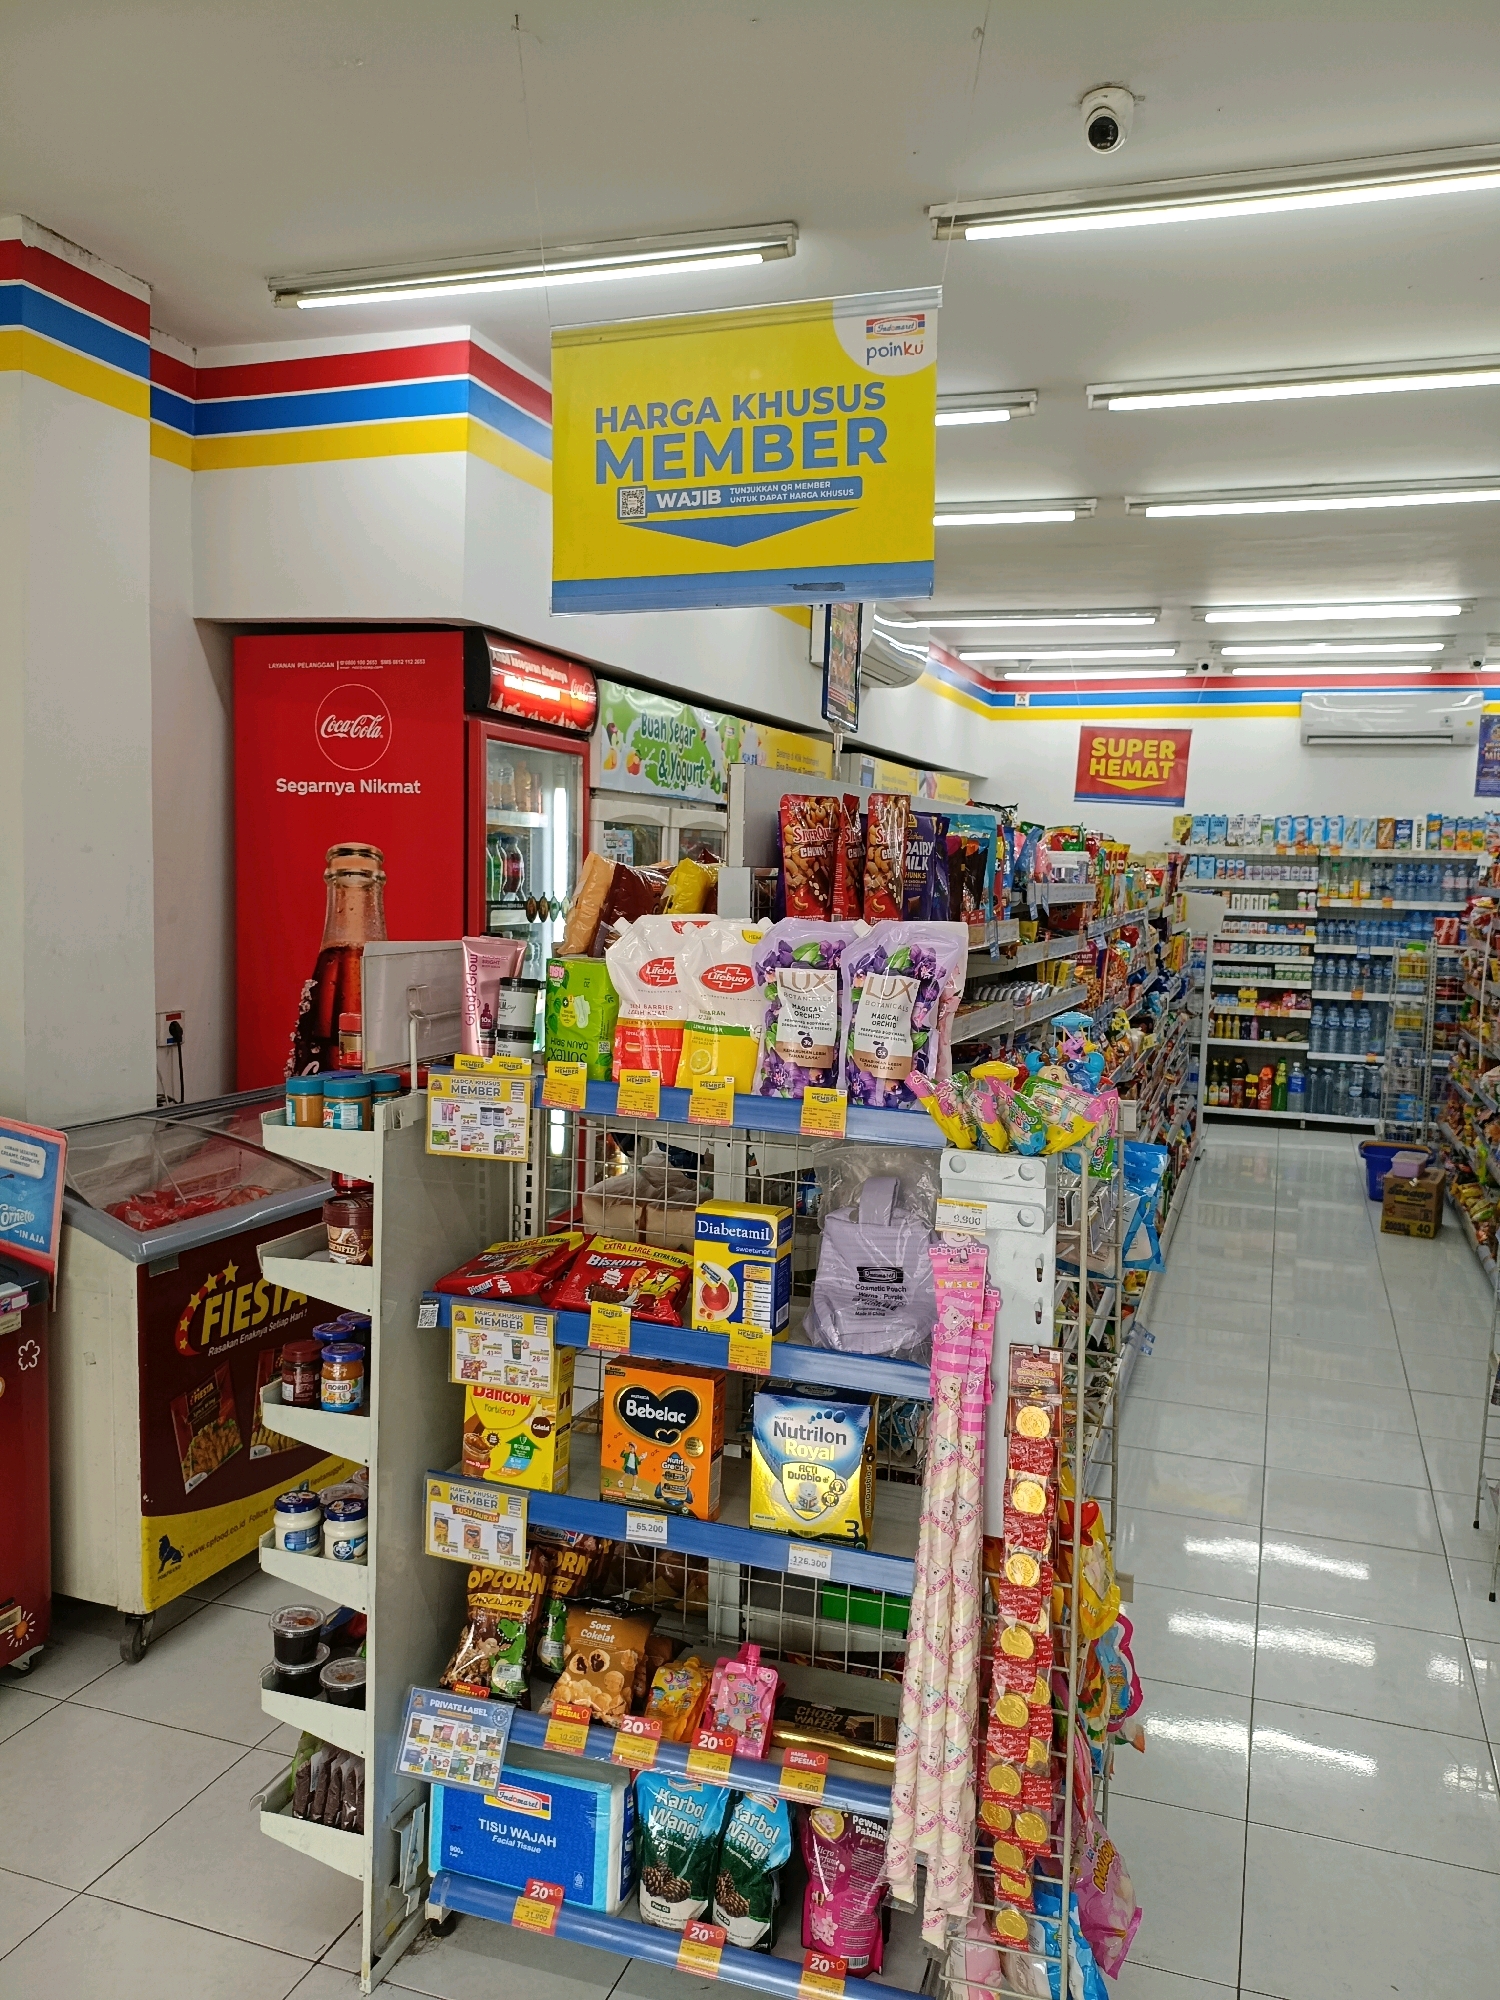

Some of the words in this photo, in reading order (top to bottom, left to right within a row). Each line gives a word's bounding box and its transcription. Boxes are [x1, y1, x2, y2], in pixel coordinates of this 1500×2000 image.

[866, 340, 924, 366] poinku
[595, 396, 722, 434] HARGA
[732, 381, 886, 422] KHUSUS
[596, 416, 888, 485] MEMBER
[730, 484, 779, 495] TUNJUKKAN
[781, 482, 794, 492] QR
[795, 480, 831, 491] MEMBER
[730, 494, 758, 504] UNTUK
[759, 492, 788, 502] DAPAT
[789, 490, 819, 500] HARGA
[820, 488, 855, 499] KHUSUS
[656, 488, 722, 509] WAJIB
[641, 712, 667, 743] Buah
[669, 715, 697, 752] Segar
[1091, 736, 1176, 760] SUPER
[658, 747, 668, 780] &
[670, 750, 707, 792] Yogurt
[1089, 757, 1175, 779] HEMAT
[276, 777, 355, 796] Segarnya
[360, 778, 421, 795] Nikmat
[905, 871, 927, 880] HUNKS
[707, 971, 752, 985] Lifebuoy
[779, 971, 835, 994] LUX
[464, 953, 482, 1027] Glad2Glow
[866, 978, 913, 1004] LUX
[792, 1003, 824, 1013] MAGICAL
[865, 1001, 909, 1013] BOTANICALS
[871, 1021, 898, 1029] ORCHID
[451, 1085, 501, 1097] MEMBER
[697, 1219, 771, 1242] Diabetamil
[1416, 1224, 1431, 1234] 40
[604, 1242, 626, 1252] EXTRA
[628, 1245, 652, 1256] LARGE
[653, 1251, 671, 1261] EXTRA
[735, 1246, 771, 1256] sweetener
[855, 1283, 886, 1293] Cosmetic
[886, 1285, 907, 1293] Pouch
[883, 1293, 904, 1302] Purple
[474, 1309, 497, 1317] HARGA
[498, 1313, 524, 1321] KHUSUS
[474, 1316, 524, 1330] MEMBER
[208, 1338, 239, 1357] Rasakan
[240, 1325, 269, 1345] Enaknya
[268, 1317, 289, 1333] Setiap
[625, 1399, 688, 1425] Bebelac
[773, 1420, 848, 1446] Nutrilon
[784, 1438, 836, 1462] Royal
[667, 1457, 685, 1466] Nutri
[799, 1464, 818, 1475] ACTI
[450, 1485, 471, 1495] HARGA
[473, 1489, 499, 1500] KHUSUS
[450, 1492, 498, 1509] MEMBER
[249, 1506, 270, 1524] Follow
[454, 1506, 472, 1516] SUSU
[472, 1510, 499, 1523] MURAH
[636, 1522, 664, 1533] 65.200
[844, 1518, 861, 1543] 3
[793, 1555, 828, 1569] 126.300
[590, 1619, 612, 1633] Soes
[580, 1628, 616, 1645] Cokelat
[430, 1698, 463, 1712] PRIVATE
[463, 1706, 488, 1717] LABEL
[556, 1708, 581, 1720] SPESIAL
[797, 1705, 844, 1724] CHOCO
[794, 1714, 839, 1732] WAFER
[789, 1756, 818, 1768] SPESIAL
[797, 1782, 820, 1792] 6.500
[497, 1791, 540, 1810] Indomaret
[655, 1787, 709, 1822] Karbol
[651, 1804, 701, 1841] Wangi
[478, 1817, 508, 1836] TISU
[509, 1826, 558, 1849] WAJAH
[491, 1834, 516, 1849] Facial
[516, 1840, 543, 1855] Tissue
